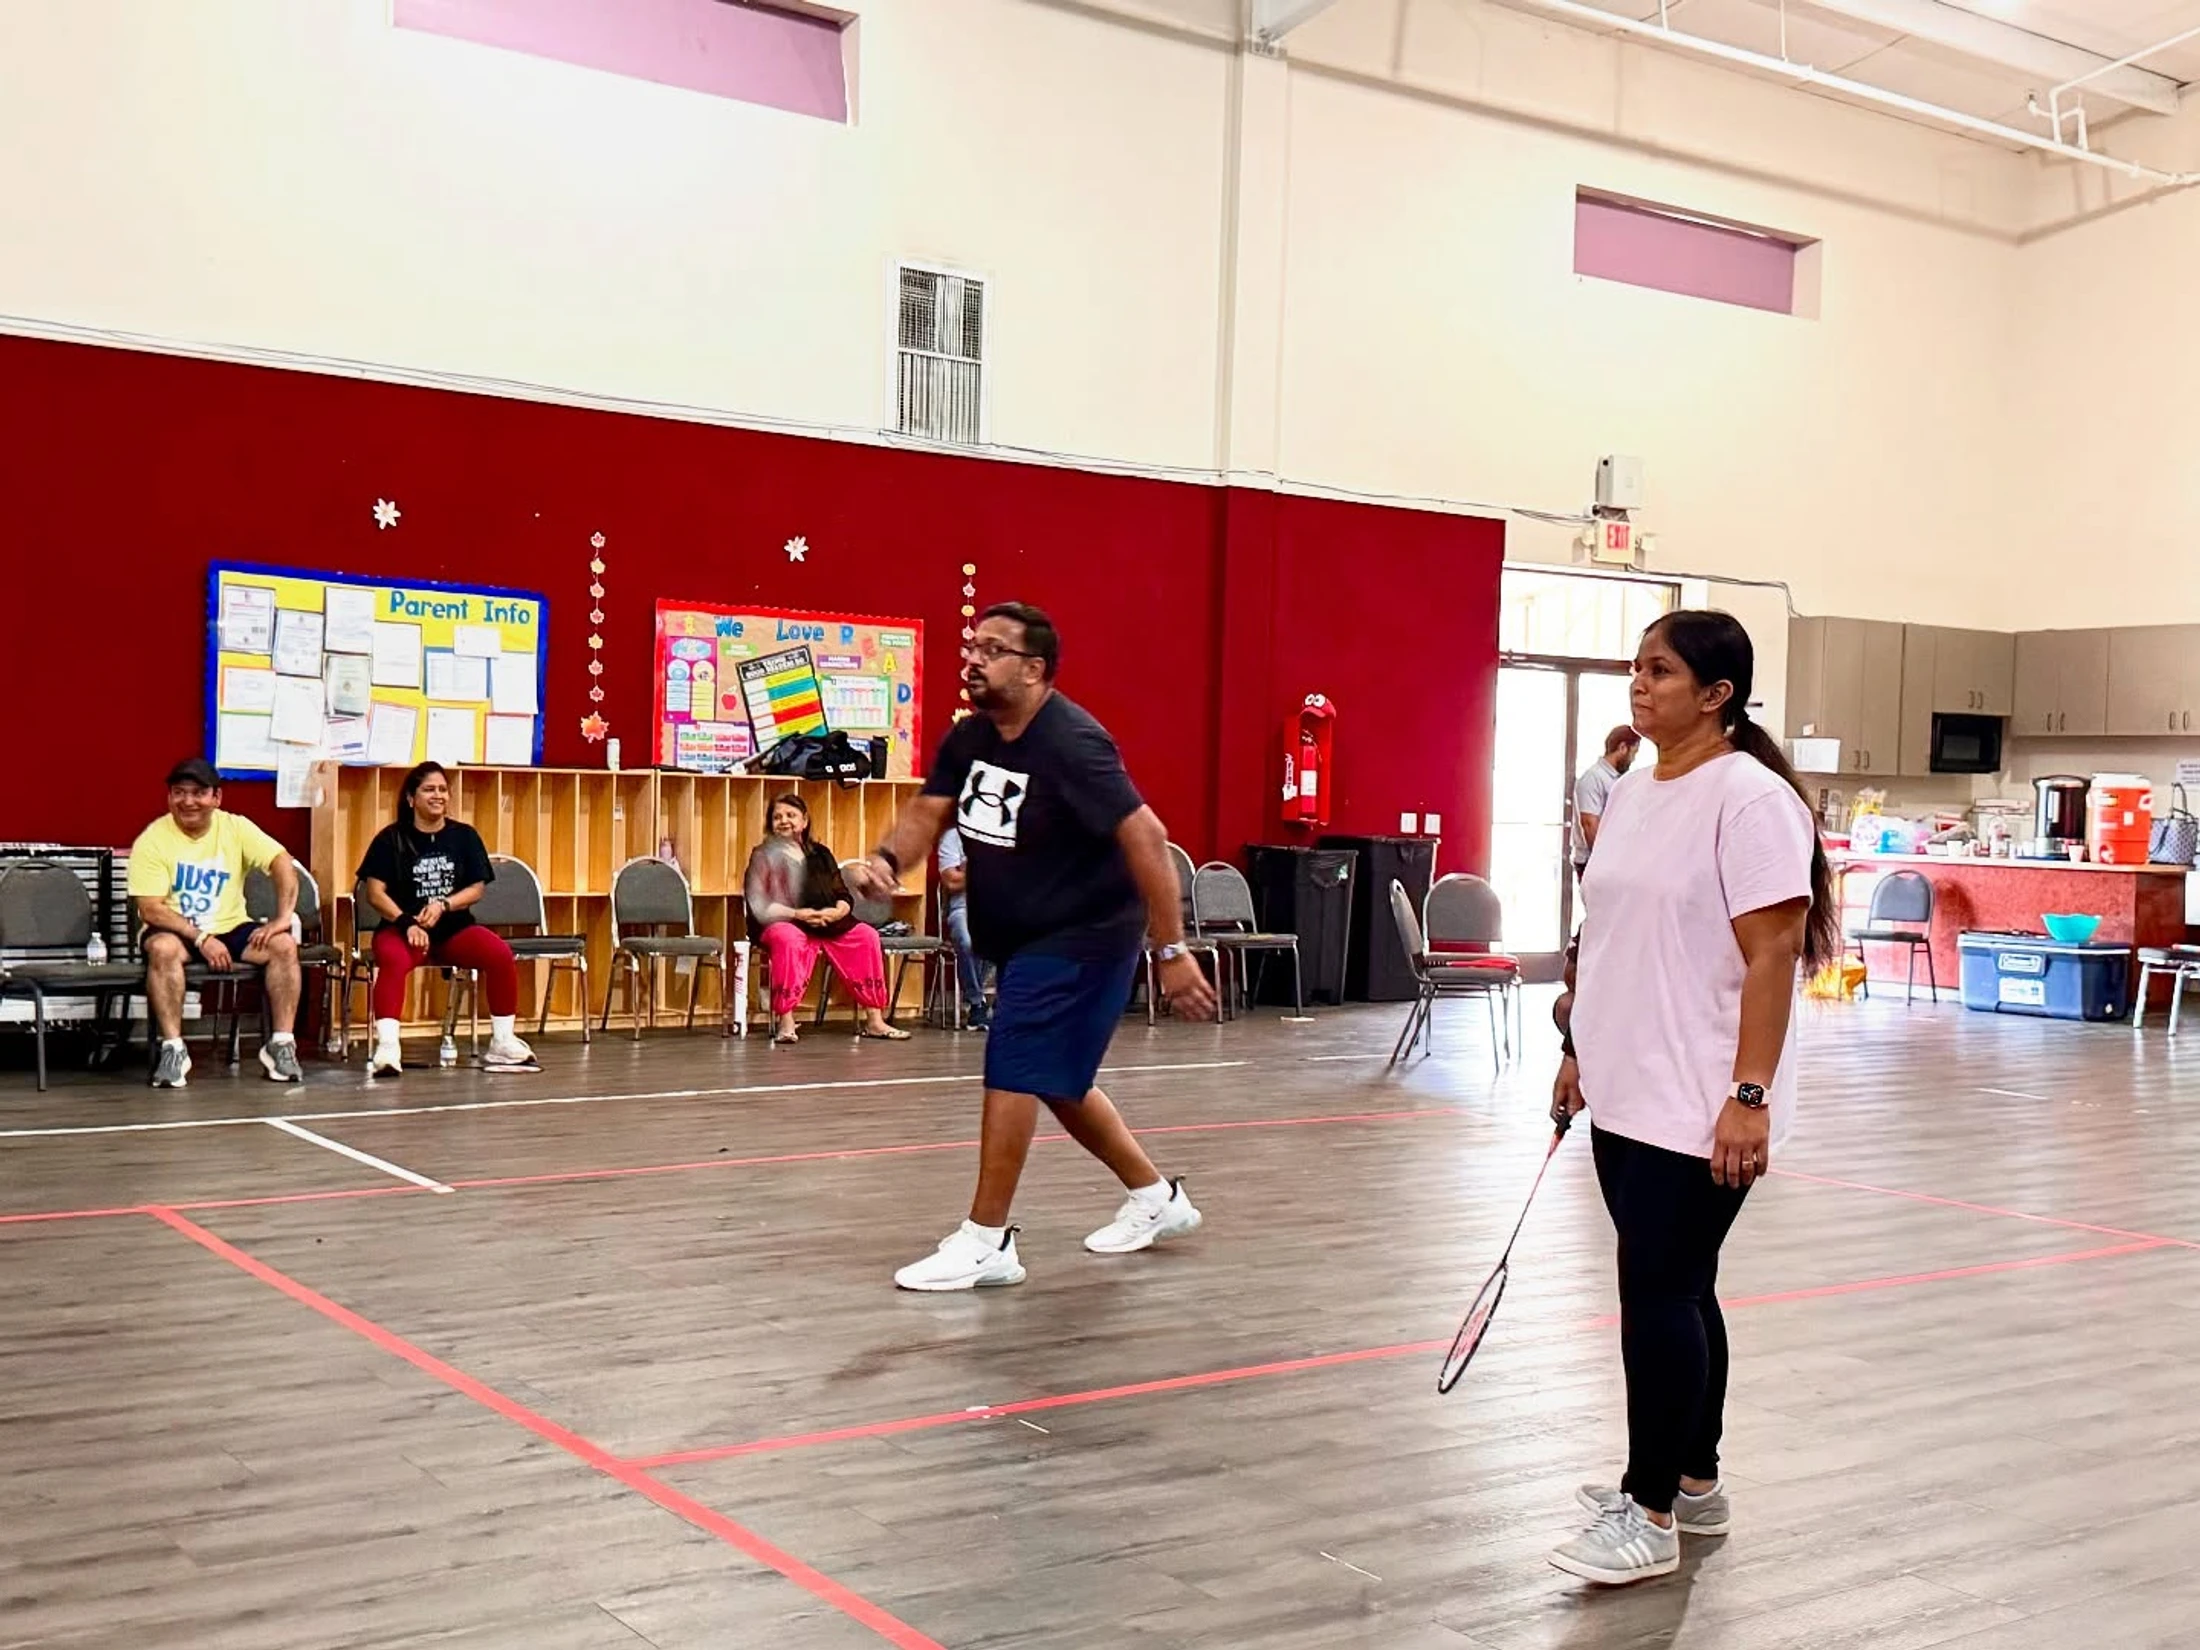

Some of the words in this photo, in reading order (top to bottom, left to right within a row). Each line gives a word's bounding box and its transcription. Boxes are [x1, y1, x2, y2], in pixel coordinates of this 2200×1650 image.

[1607, 524, 1630, 549] EXIT
[390, 590, 468, 620] Parent
[483, 600, 531, 625] Info
[715, 616, 744, 637] We
[776, 619, 825, 642] Love
[171, 861, 230, 897] JUST
